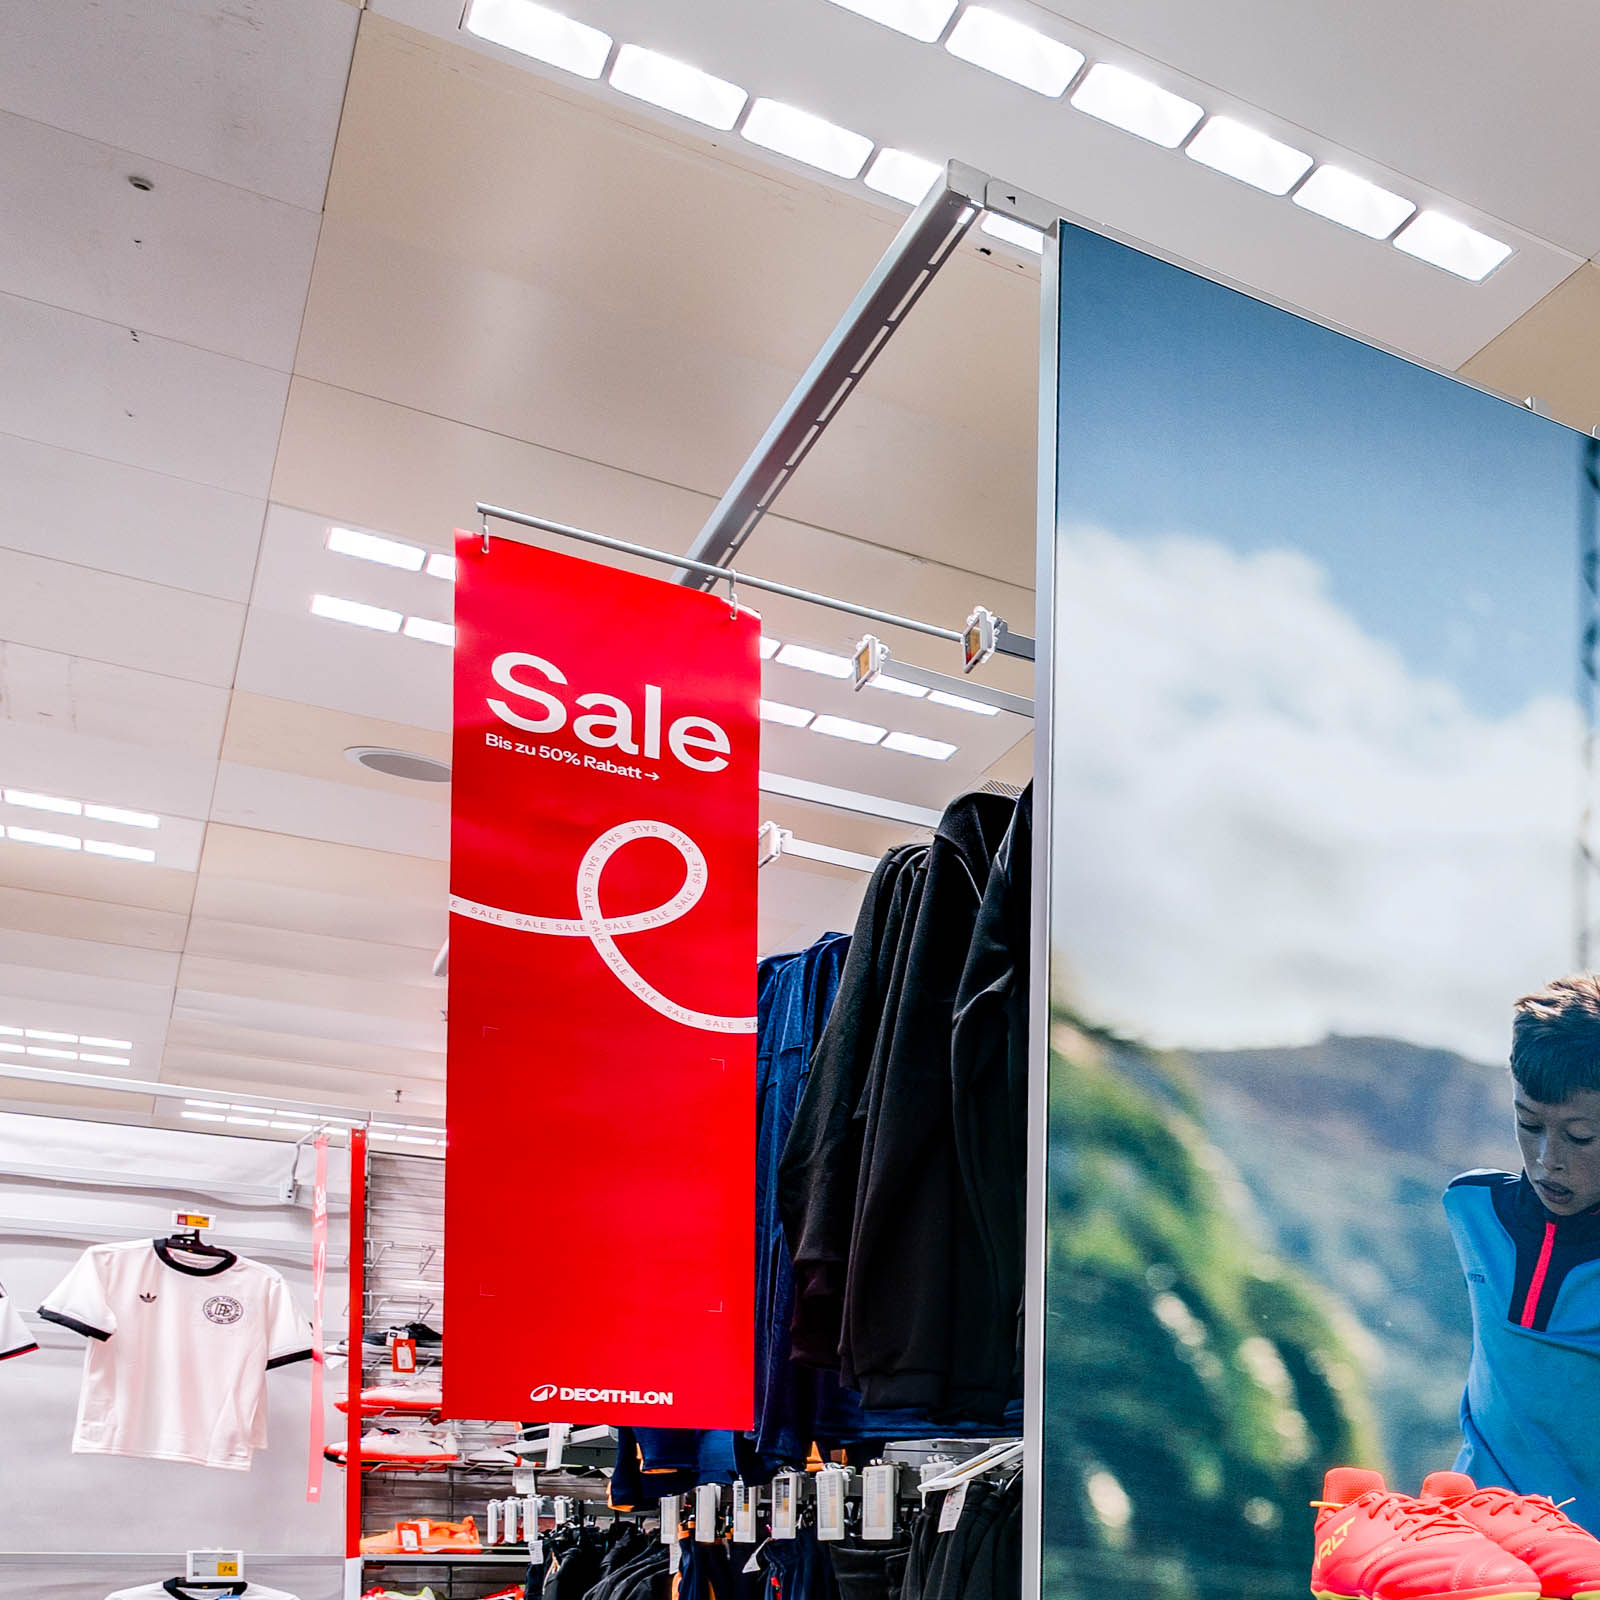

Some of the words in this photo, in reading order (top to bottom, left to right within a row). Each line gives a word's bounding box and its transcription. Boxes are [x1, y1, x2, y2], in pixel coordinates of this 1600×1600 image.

[486, 651, 731, 773] Sale
[485, 732, 513, 751] Bis
[515, 742, 536, 756] zu
[538, 745, 581, 766] 50%
[583, 754, 643, 780] Rabatt
[559, 1386, 674, 1406] DECATHLON
